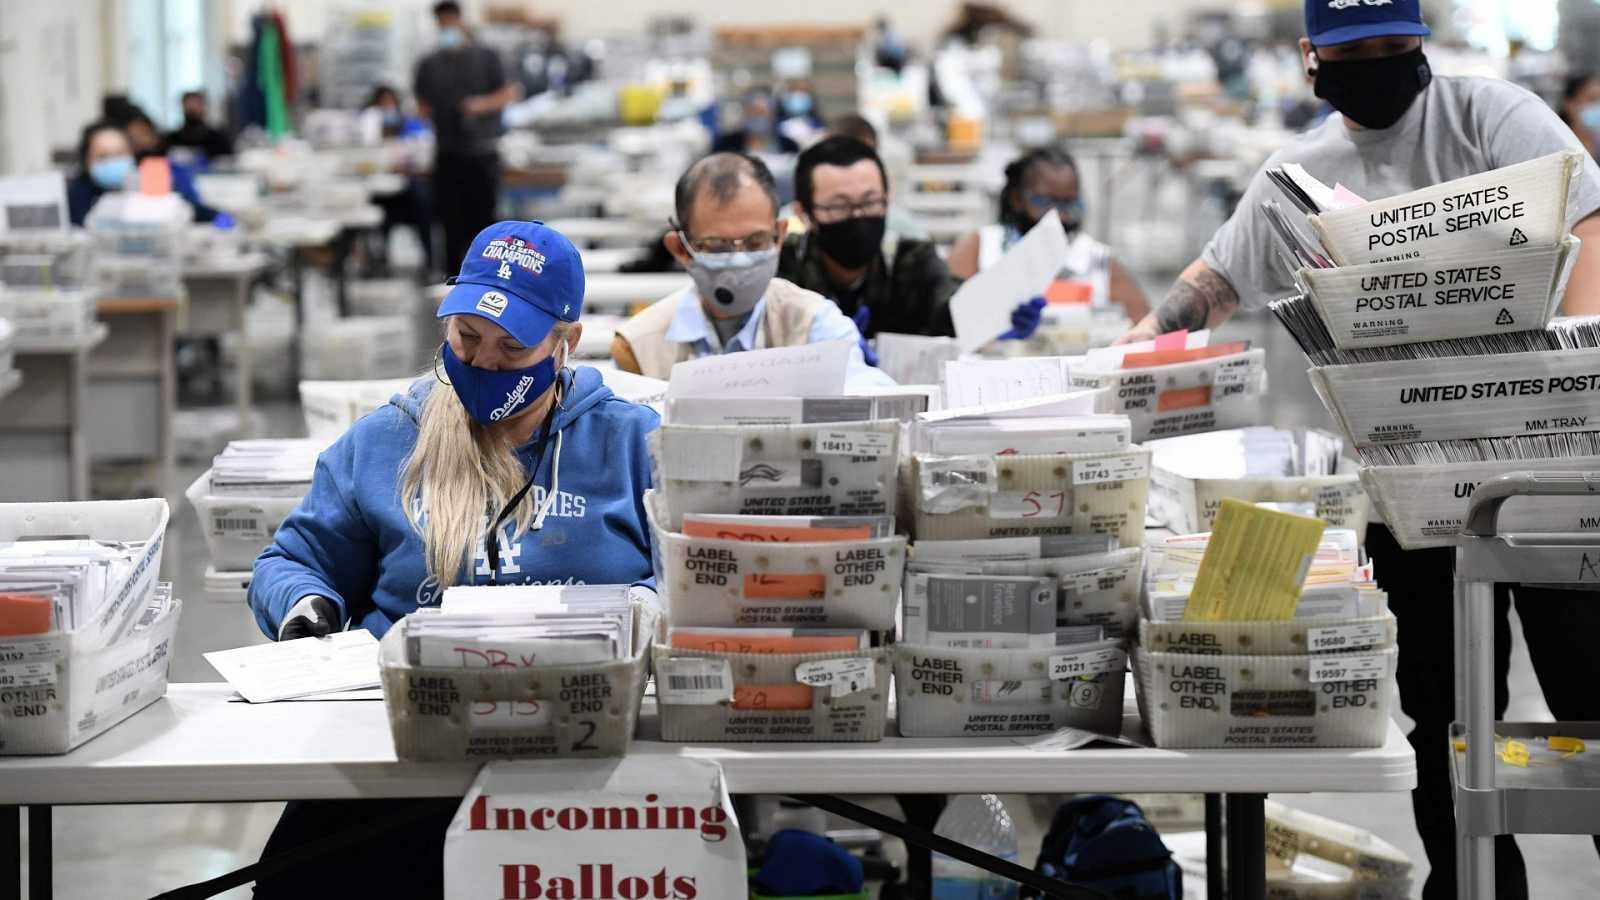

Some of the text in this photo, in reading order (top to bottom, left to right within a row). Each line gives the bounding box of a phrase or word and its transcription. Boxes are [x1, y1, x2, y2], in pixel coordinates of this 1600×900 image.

[1370, 185, 1509, 228] UNITED STATES
[1368, 201, 1525, 251] POSTAL SERVICE
[482, 245, 545, 275] CHAMPIONS
[497, 260, 513, 280] LA
[1361, 265, 1501, 292] UNITED STATES
[1355, 283, 1516, 313] POSTAL SERVICE
[1352, 318, 1405, 329] WARNING
[1120, 374, 1155, 386] LABEL
[1118, 386, 1156, 398] OTHER
[1224, 384, 1244, 396] END
[1400, 373, 1600, 404] UNITED STATES POST
[489, 375, 534, 423] Dodgers
[1124, 399, 1148, 410] END
[1374, 423, 1415, 433] WARNING
[1525, 416, 1588, 432] MM TRAY
[743, 496, 785, 507] UNITED
[788, 495, 832, 506] STATES
[1427, 518, 1463, 528] WARNIN
[990, 526, 1073, 536] UNITED STATES
[687, 546, 737, 562] LABEL
[836, 548, 885, 562] LABEL
[685, 560, 738, 574] OTHER
[834, 560, 886, 575] OTHER
[695, 573, 728, 586] END
[843, 573, 875, 587] END
[742, 605, 824, 614] UNITED STATES
[1167, 632, 1222, 647] LABEL
[912, 655, 963, 672] LABEL
[1054, 662, 1086, 674] 20121
[561, 673, 610, 689] LABEL
[911, 669, 964, 684] OTHER
[1170, 667, 1226, 681] LABEL
[409, 677, 457, 690] LABEL
[921, 682, 953, 696] END
[1169, 680, 1227, 695] OTHER
[1321, 679, 1377, 695] OTHER
[407, 690, 460, 703] OTHER
[559, 686, 612, 701] OTHER
[570, 700, 603, 714] END
[1180, 696, 1216, 710] END
[1333, 694, 1367, 709] END
[14, 703, 48, 718] END
[418, 703, 450, 717] END
[728, 716, 811, 725] UNITED STATES
[967, 713, 1050, 723] UNITED STATES
[724, 726, 815, 736] POSTAL SERVICE
[963, 722, 1054, 733] POSTAL SERVICE
[1228, 725, 1314, 736] UNITED STATES
[571, 720, 599, 751] 2
[1223, 735, 1316, 746] POSTAL SERVICE
[467, 793, 728, 842] Incoming
[498, 863, 697, 900] Ballots
